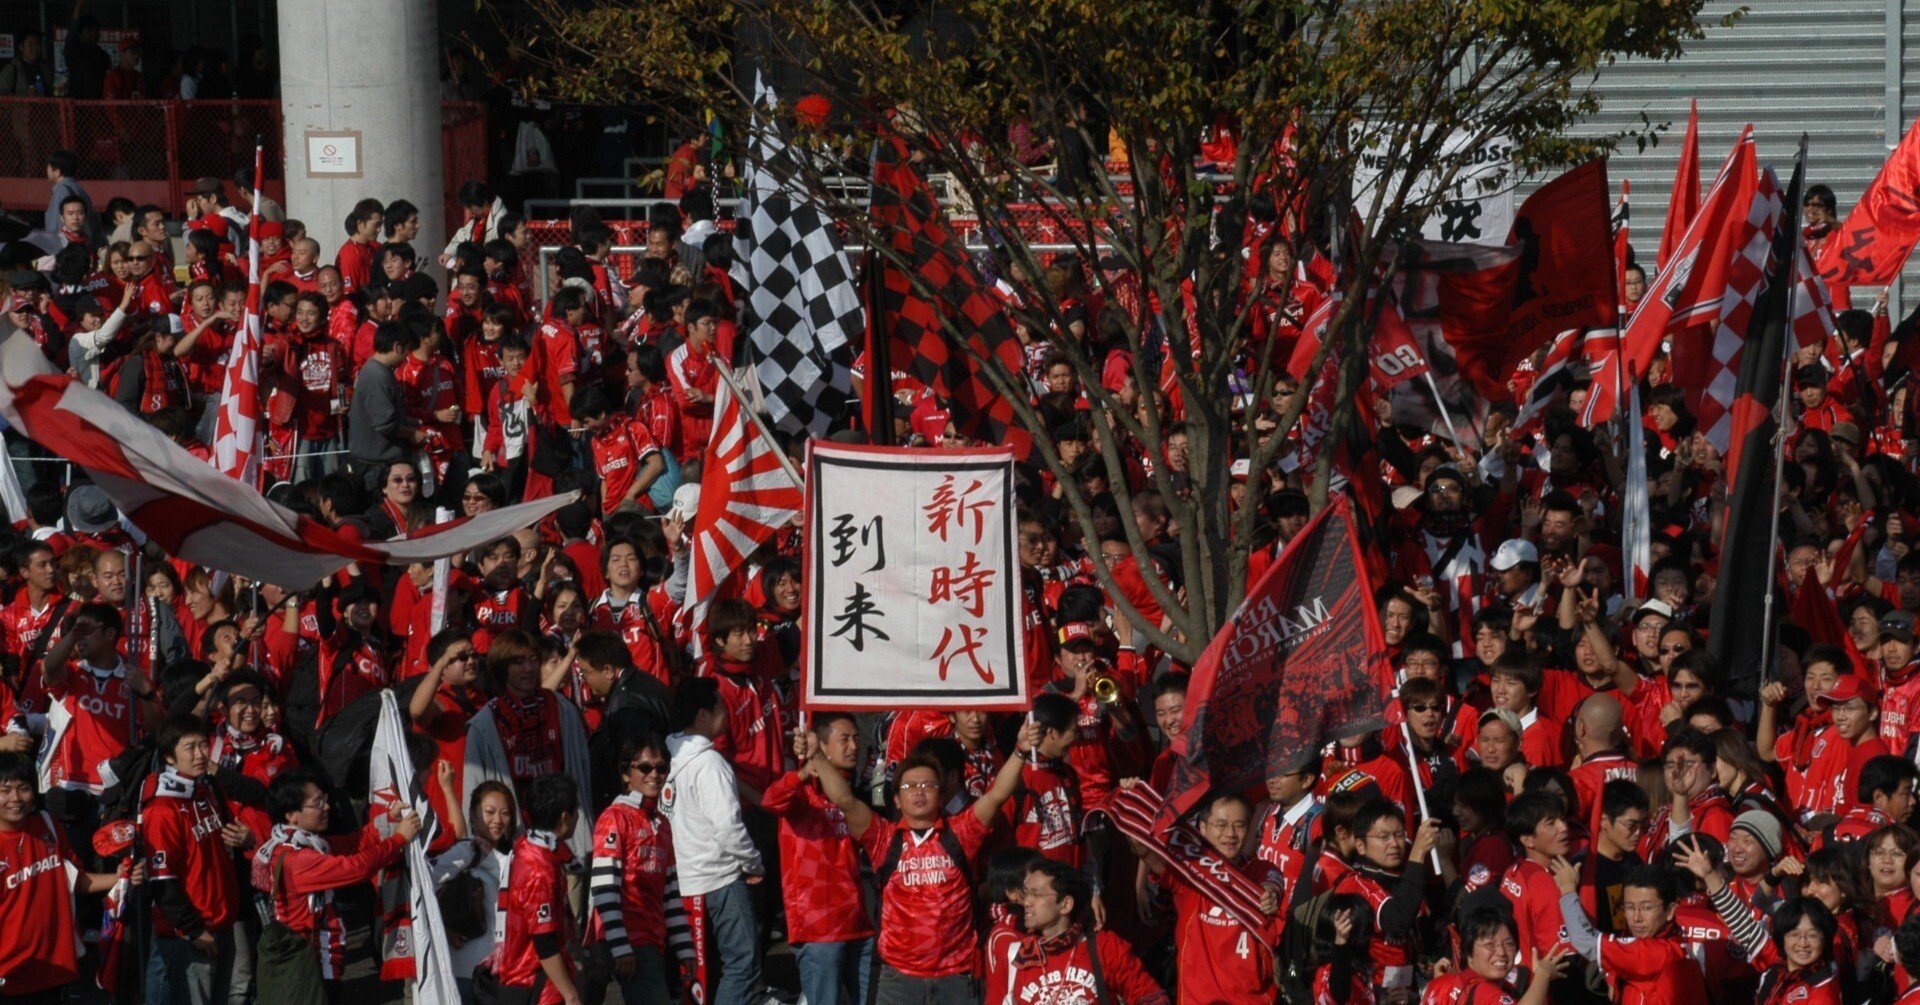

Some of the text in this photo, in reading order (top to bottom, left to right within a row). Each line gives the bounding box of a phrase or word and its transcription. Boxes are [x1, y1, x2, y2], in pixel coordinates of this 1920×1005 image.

[151, 394, 162, 411] 8
[827, 512, 890, 653] 到来
[921, 473, 997, 687] 新時代
[78, 694, 126, 720] COLT
[5, 853, 62, 890] COMPAQ
[903, 869, 947, 887] URAWA
[1235, 930, 1250, 960] 4
